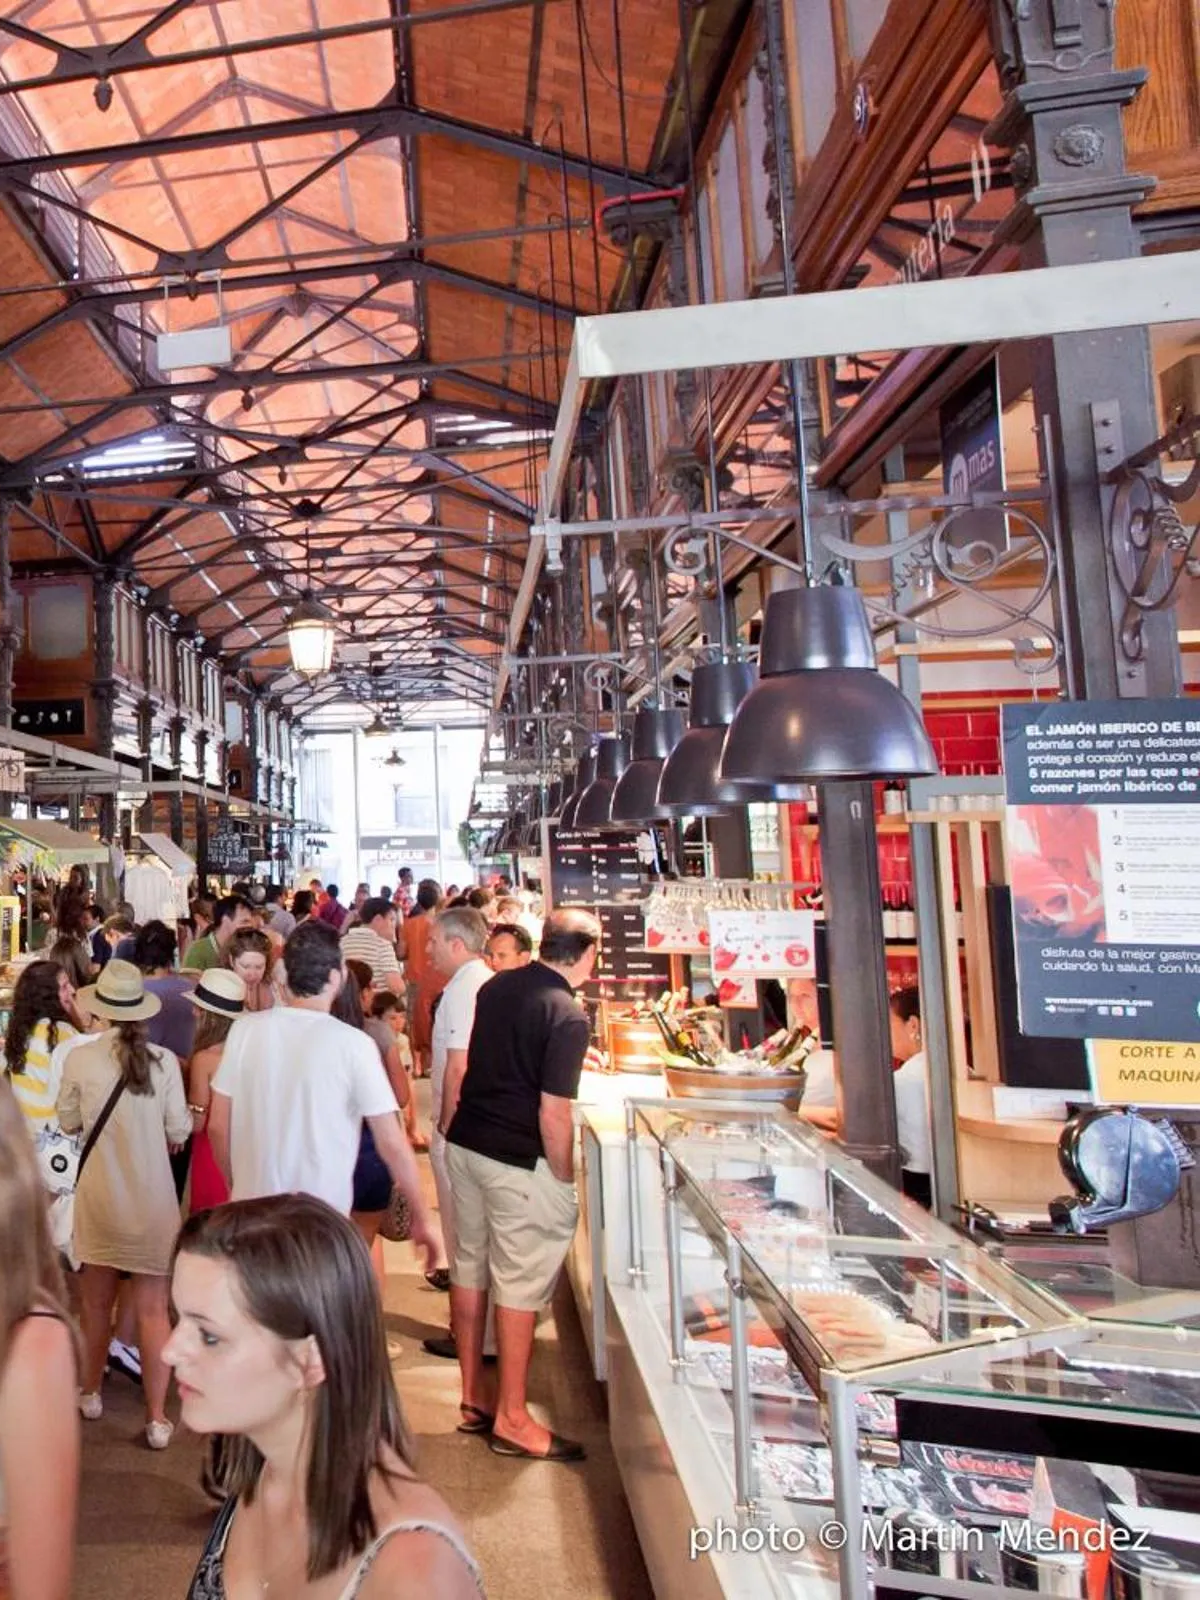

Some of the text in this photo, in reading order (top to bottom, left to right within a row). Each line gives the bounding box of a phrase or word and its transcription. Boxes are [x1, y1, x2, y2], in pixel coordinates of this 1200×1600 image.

[1025, 724, 1043, 736] EL
[1046, 722, 1096, 736] JAMÓN
[1161, 721, 1182, 733] DE
[1027, 739, 1074, 750] además
[1076, 738, 1093, 749] de
[1028, 754, 1072, 767] protege
[1074, 753, 1084, 763] el
[1086, 752, 1134, 763] corazón
[1135, 754, 1144, 765] y
[1145, 752, 1188, 763] reduce
[1041, 768, 1095, 778] razones
[1099, 768, 1122, 780] por
[1126, 767, 1148, 777] las
[1151, 767, 1178, 780] que
[1182, 768, 1199, 777] se
[1030, 783, 1074, 793] comer
[1077, 781, 1121, 794] jamón
[1178, 780, 1197, 791] de
[1113, 835, 1122, 845] 2
[1115, 862, 1125, 872] 3
[1117, 884, 1126, 893] 4
[1041, 947, 1085, 958] disfruta
[1088, 948, 1105, 958] de
[1107, 948, 1118, 959] la
[1121, 948, 1156, 961] mejor
[1042, 960, 1098, 971] cuidando
[1101, 962, 1114, 972] tu
[1158, 964, 1182, 974] con
[1119, 1045, 1196, 1059] CORTE A
